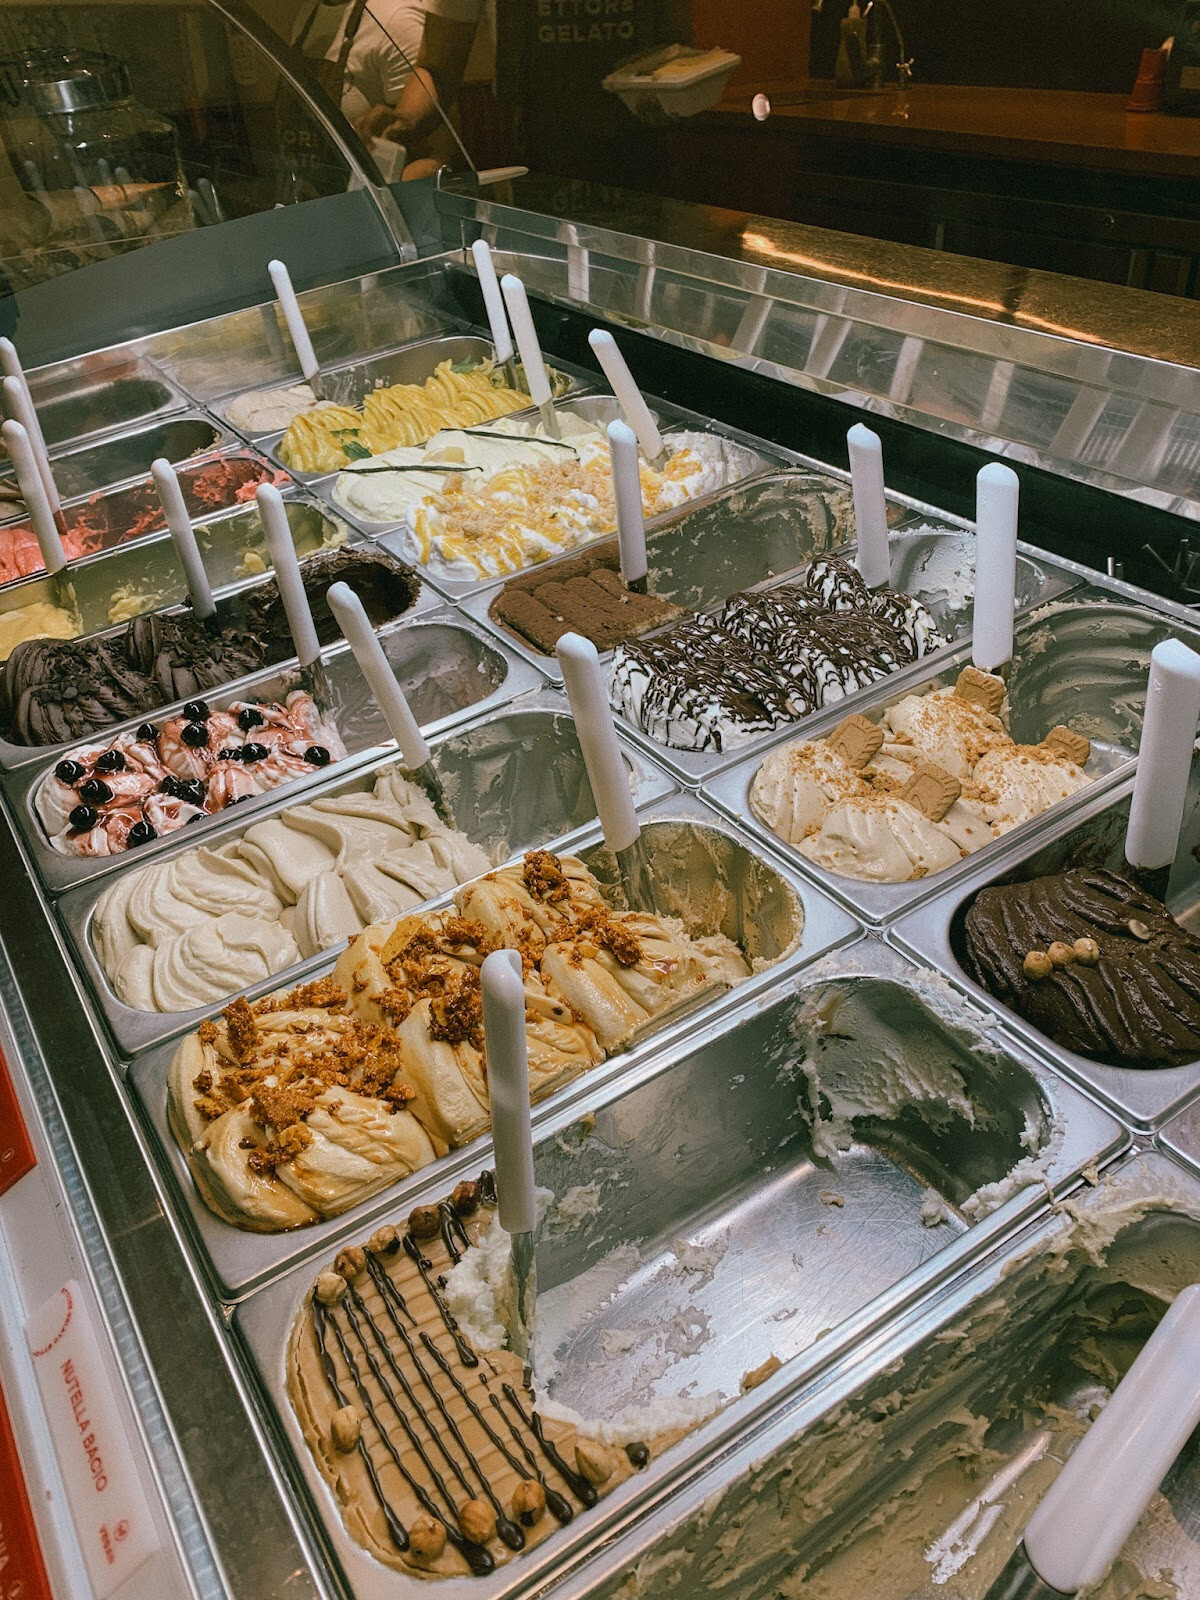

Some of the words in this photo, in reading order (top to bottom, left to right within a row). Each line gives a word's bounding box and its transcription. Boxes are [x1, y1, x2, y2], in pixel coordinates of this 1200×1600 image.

[537, 19, 635, 44] GELATO
[60, 1358, 91, 1436] NUTELLA
[82, 1432, 108, 1493] BACIO
